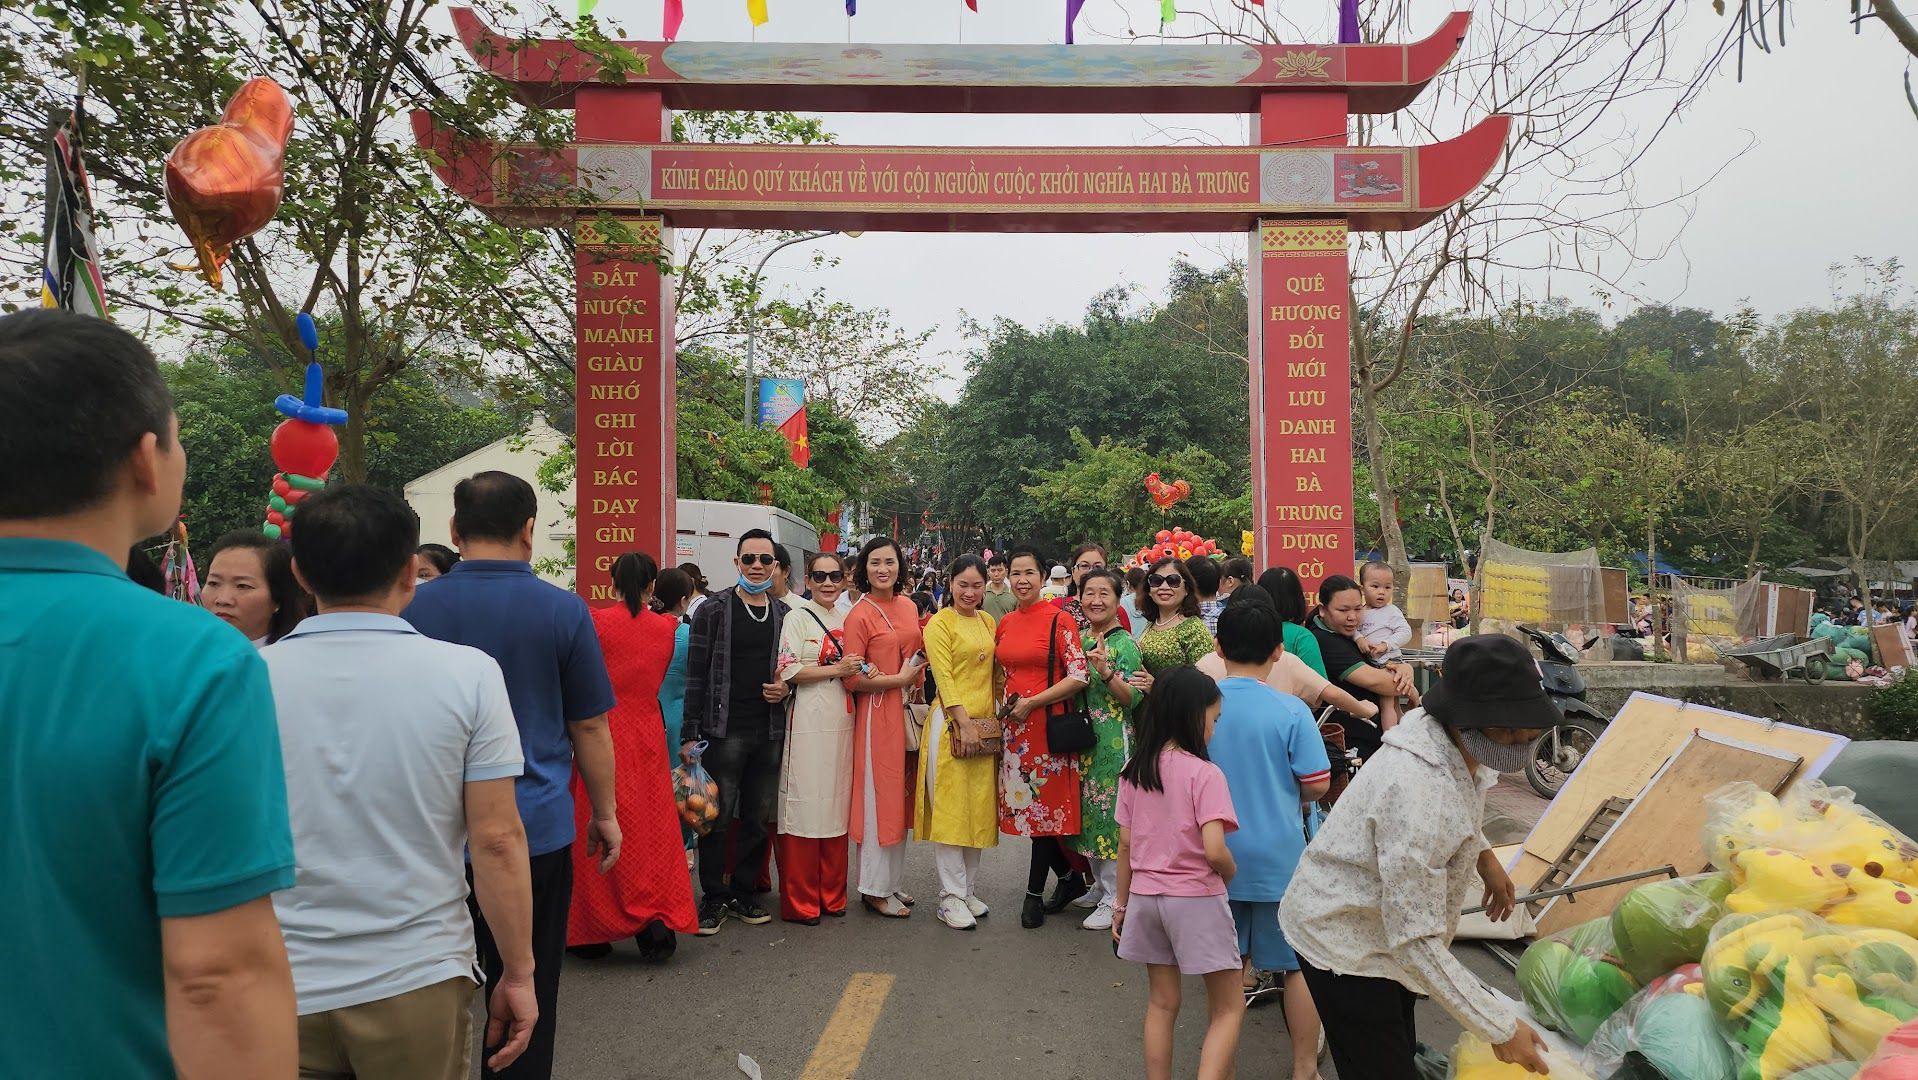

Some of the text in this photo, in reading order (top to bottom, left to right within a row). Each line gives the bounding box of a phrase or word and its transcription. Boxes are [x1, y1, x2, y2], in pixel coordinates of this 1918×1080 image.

[661, 159, 1249, 200] KÍNH CHÀO QUÝ KHÁCH VỀ VỚI CỘI NGUỒN CUỘC KHỞI NGHĨA HAI BÀ TRƯNG
[592, 264, 638, 287] ĐẤT
[1287, 273, 1324, 295] QUÊ
[1271, 305, 1341, 320] HƯƠNG
[584, 328, 653, 347] MẠNH
[1289, 326, 1324, 348] ĐỔI
[588, 352, 643, 371] GIÀU
[1288, 358, 1326, 377] MỚI
[590, 380, 640, 399] NHỚ
[1289, 390, 1325, 406] LƯU
[595, 414, 636, 428] GHI
[1280, 420, 1336, 434] DANH
[597, 437, 633, 456] LỜI
[1291, 448, 1326, 463] HAI
[594, 466, 637, 485] BÁC
[1296, 472, 1322, 491] BÀ
[593, 499, 639, 518] DẠY
[1276, 505, 1343, 520] TRƯNG
[596, 523, 635, 542] GÌN
[1282, 533, 1338, 553] DỰNG
[1298, 558, 1324, 577] CỜ
